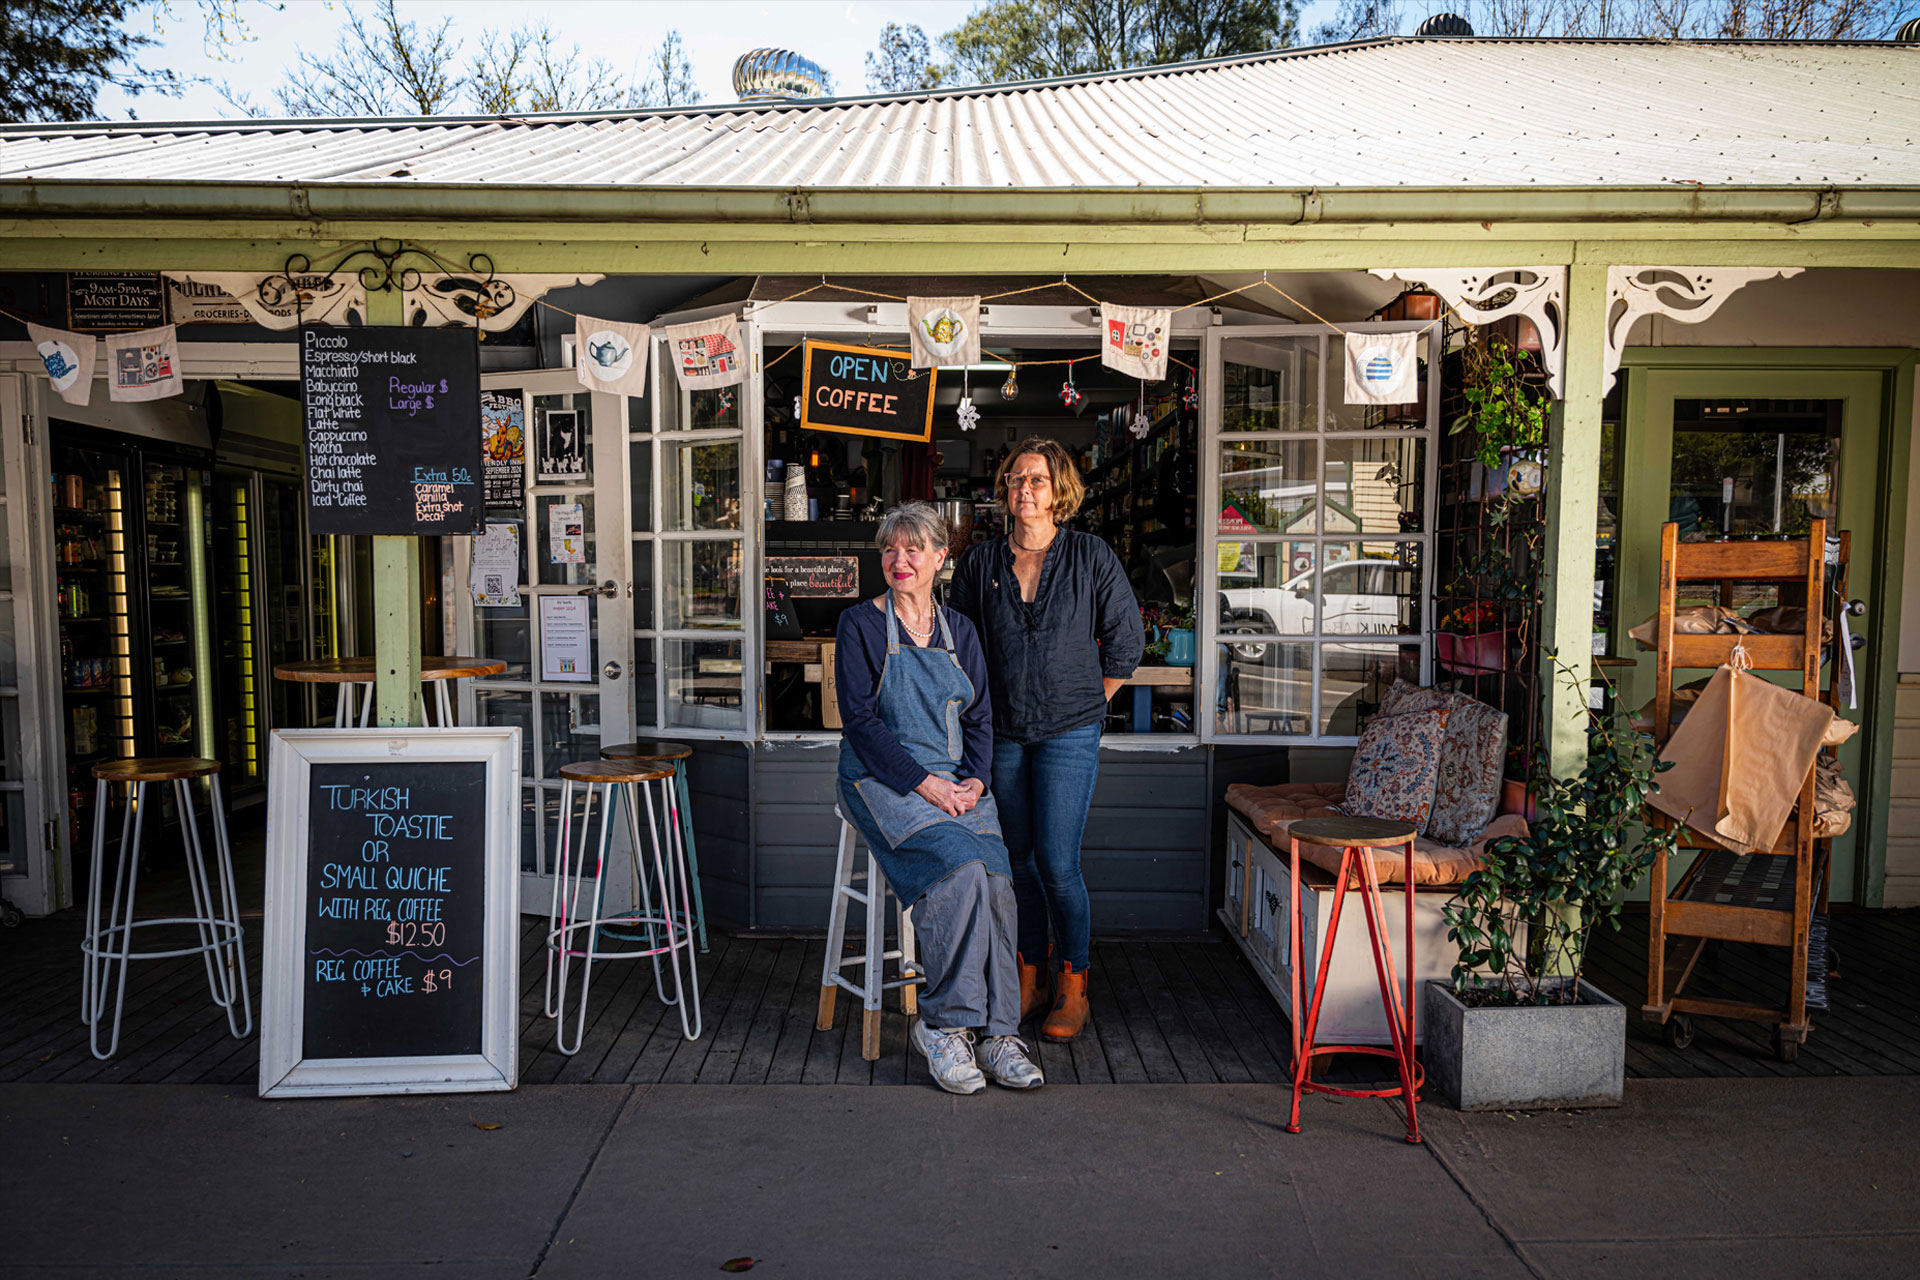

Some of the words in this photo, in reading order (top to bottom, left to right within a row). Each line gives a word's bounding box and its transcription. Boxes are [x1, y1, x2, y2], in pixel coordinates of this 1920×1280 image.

[305, 331, 348, 348] Piccolo
[305, 350, 389, 364] Espresso/short
[390, 352, 417, 364] black
[306, 364, 359, 378] Macchiato
[830, 356, 888, 383] OPEN
[306, 379, 358, 395] Babyccino
[389, 376, 436, 399] Regular
[439, 378, 449, 394] $
[306, 394, 334, 411] Long
[335, 394, 364, 406] black
[389, 397, 422, 416] Large
[425, 396, 434, 409] $
[815, 385, 899, 415] COFFEE
[308, 407, 328, 419] Flat
[308, 419, 339, 430] Latte
[309, 431, 368, 444] Cappuccino
[310, 442, 343, 454] Mocha
[310, 454, 328, 466] Hot
[328, 452, 377, 466] chocolate
[311, 466, 336, 479] Chai
[337, 466, 362, 479] latte
[415, 467, 447, 481] Extra
[311, 480, 340, 498] Dirty
[342, 480, 364, 492] chai
[415, 483, 454, 493] Caramel
[312, 494, 332, 506] Iced
[338, 493, 367, 506] Coffee
[416, 501, 441, 512] Extra
[443, 501, 464, 512] shot
[416, 511, 445, 521] Decaf
[790, 579, 808, 588] place
[766, 601, 779, 611] AKE
[320, 785, 410, 810] TURKISH
[366, 813, 453, 840] TOASTIE
[362, 841, 389, 862] OR
[321, 863, 378, 890] SMALL
[385, 866, 451, 892] QUICHE
[319, 897, 358, 920] WITH
[364, 898, 391, 921] REG
[397, 898, 444, 922] COFFEE
[386, 921, 446, 947] $12.50
[316, 960, 346, 982] REG
[353, 958, 402, 980] COFFEE
[377, 977, 414, 997] CAKE
